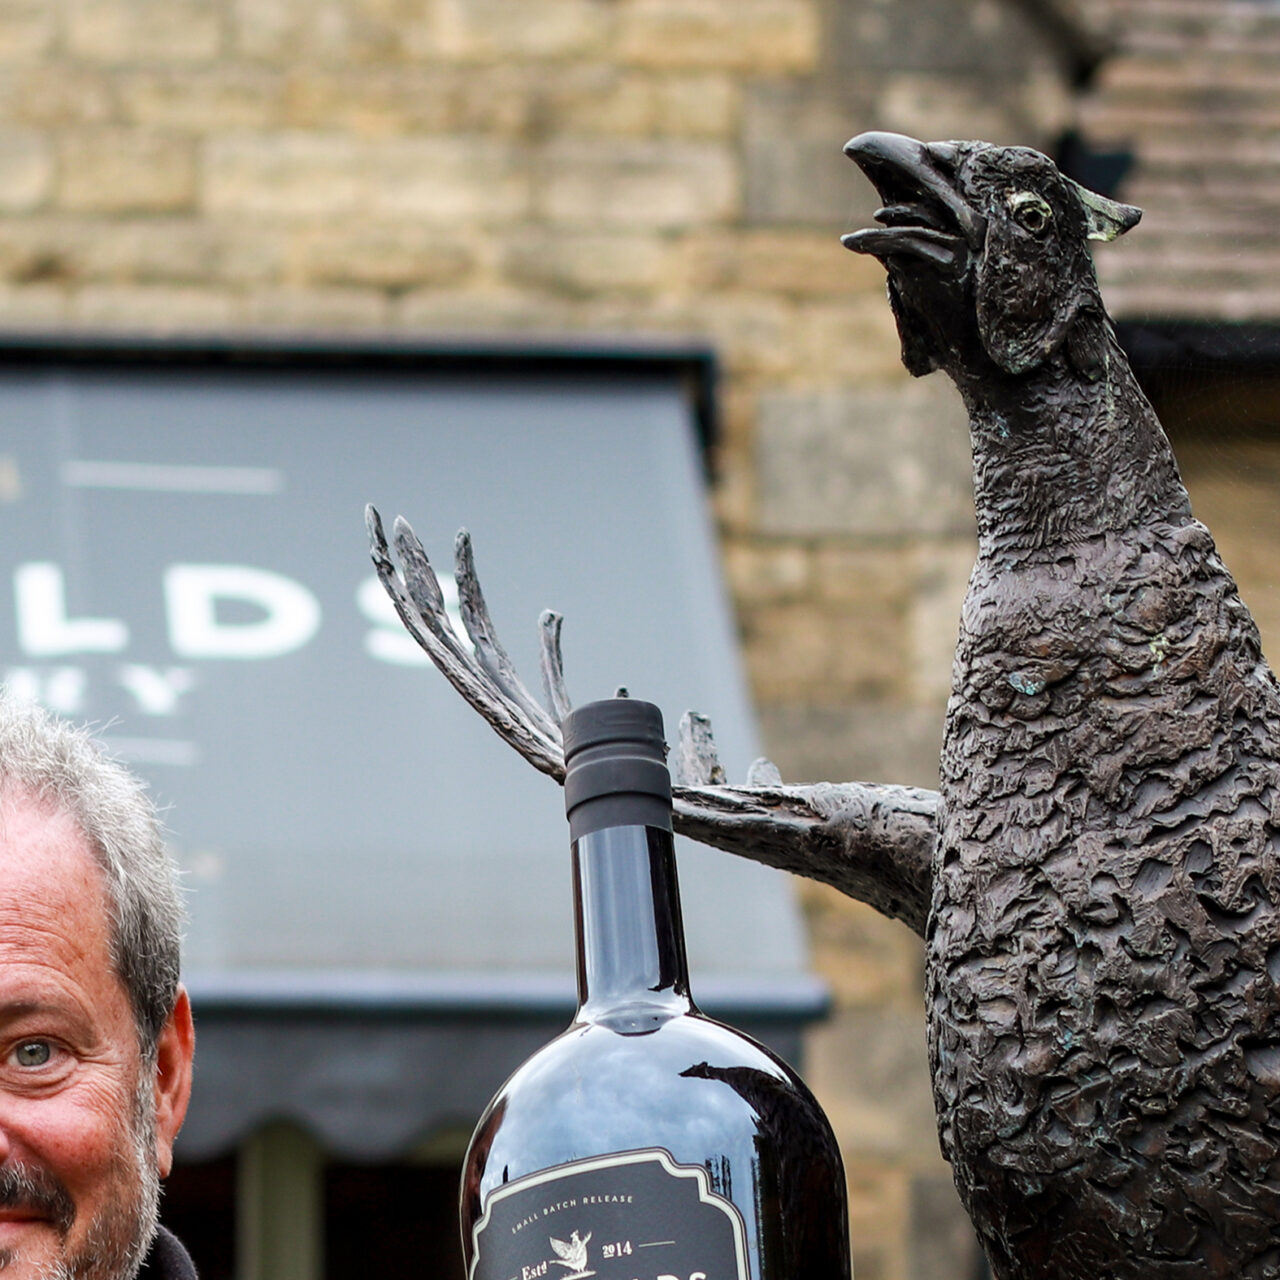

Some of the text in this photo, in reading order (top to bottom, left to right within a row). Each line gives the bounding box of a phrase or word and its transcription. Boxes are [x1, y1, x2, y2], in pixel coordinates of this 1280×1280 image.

[511, 1195, 633, 1234] SMALL BATCH RELEASE
[602, 1240, 633, 1258] 2014
